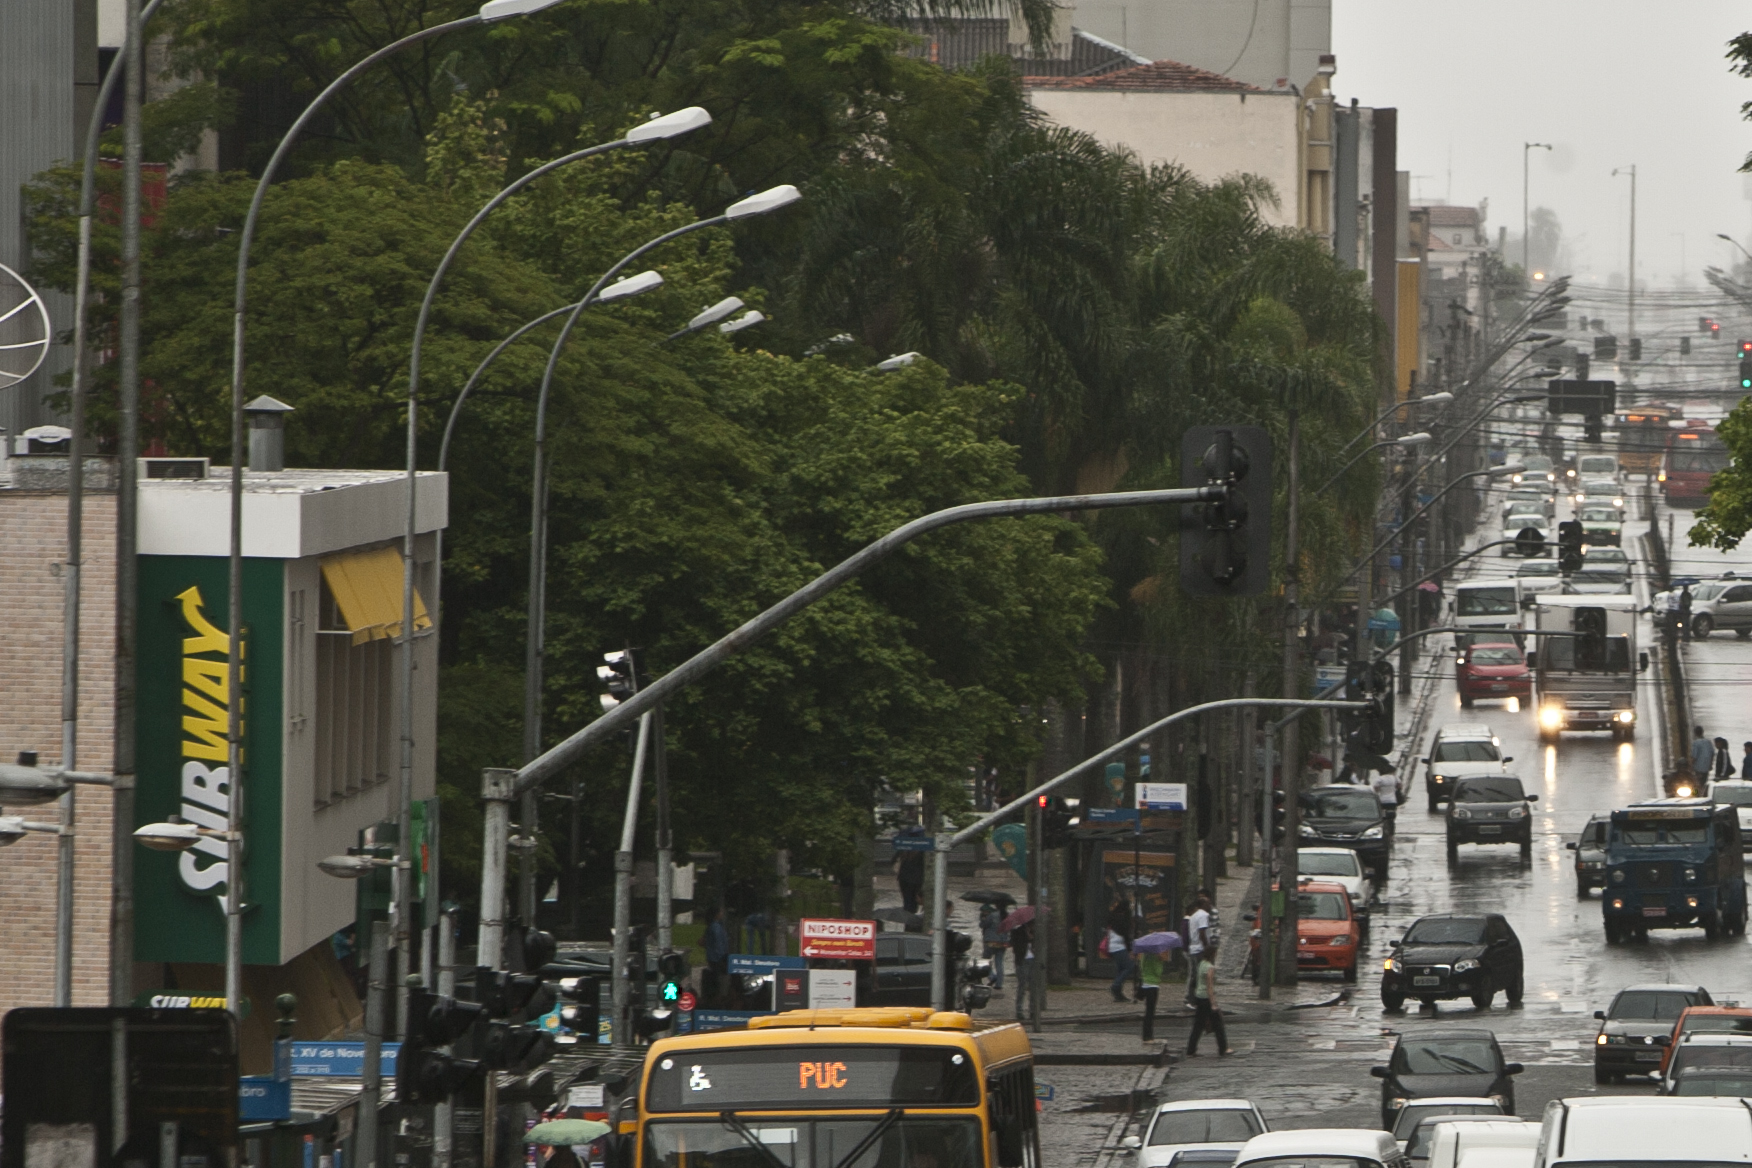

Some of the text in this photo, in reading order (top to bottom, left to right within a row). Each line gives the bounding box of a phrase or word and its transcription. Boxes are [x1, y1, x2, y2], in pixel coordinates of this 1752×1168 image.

[174, 585, 247, 916] SUBWAY
[808, 924, 869, 936] NIPOSHOP
[300, 1048, 317, 1058] XV
[319, 1048, 334, 1058] de
[799, 1061, 848, 1089] PUC
